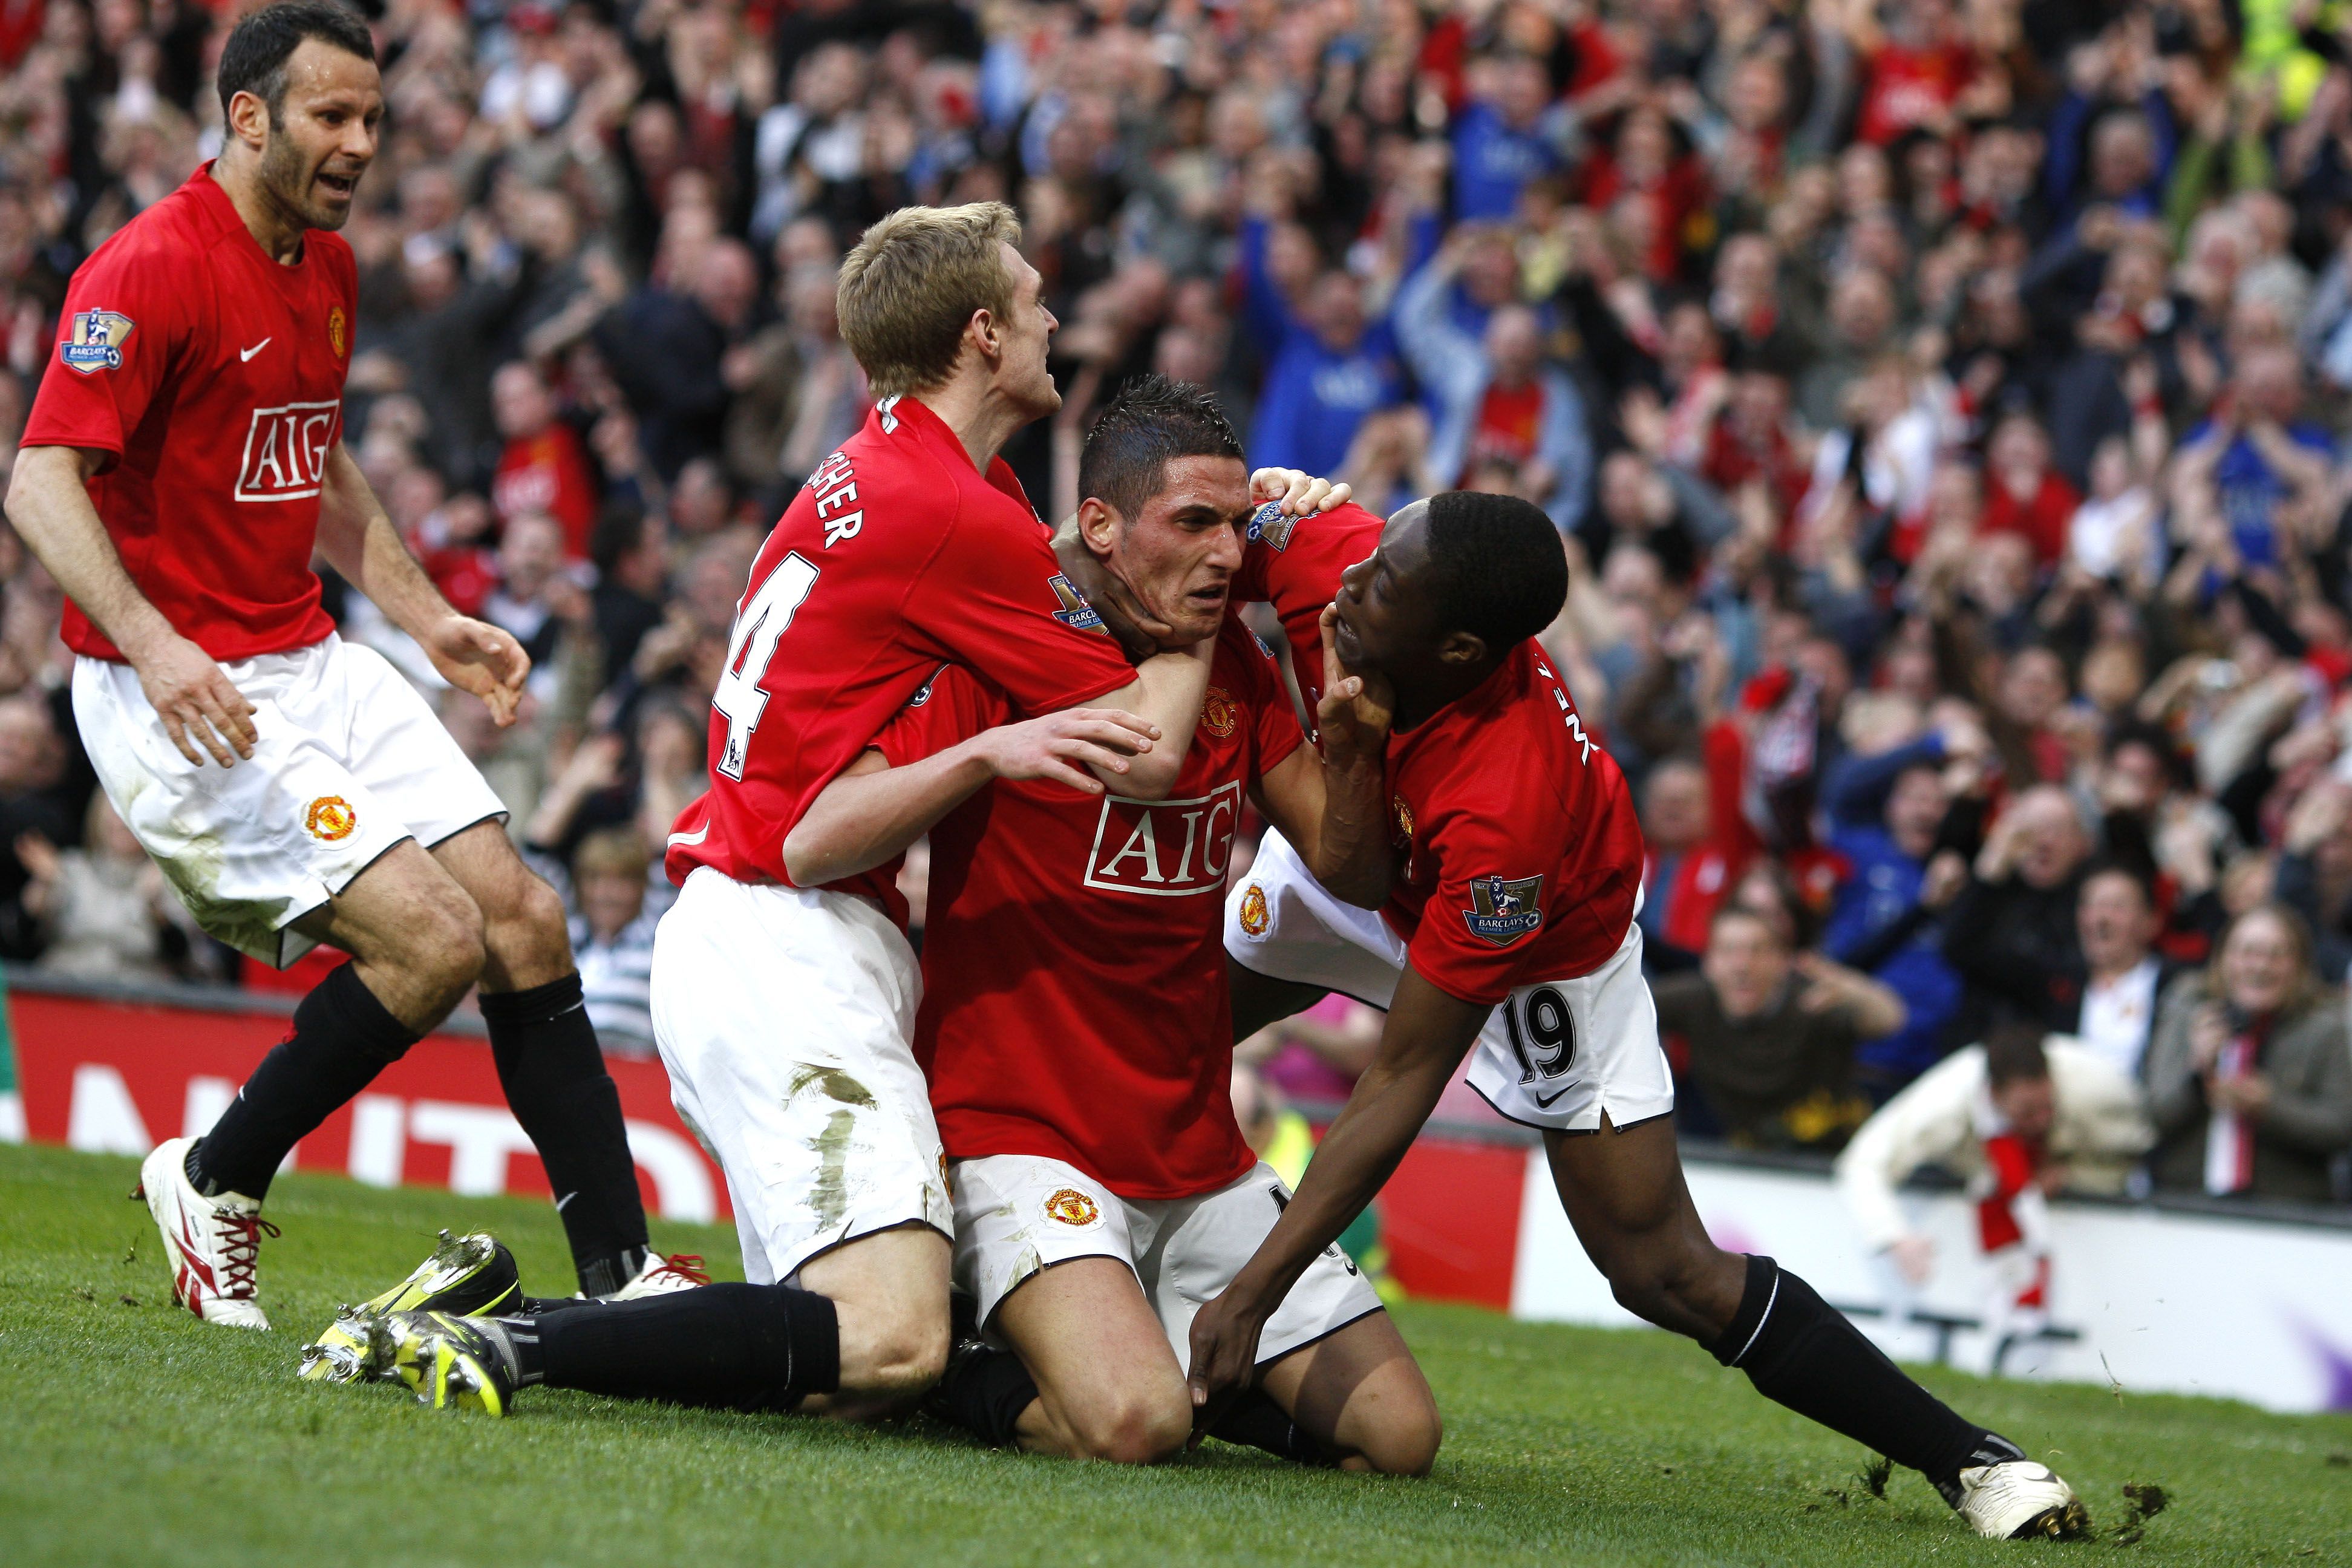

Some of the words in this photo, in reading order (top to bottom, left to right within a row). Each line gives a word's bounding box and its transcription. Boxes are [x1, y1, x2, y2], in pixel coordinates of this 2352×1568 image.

[245, 413, 330, 489] AIG
[1099, 797, 1232, 883] AIG
[1478, 917, 1524, 928] BARCLAYS
[1501, 986, 1576, 1085] 19
